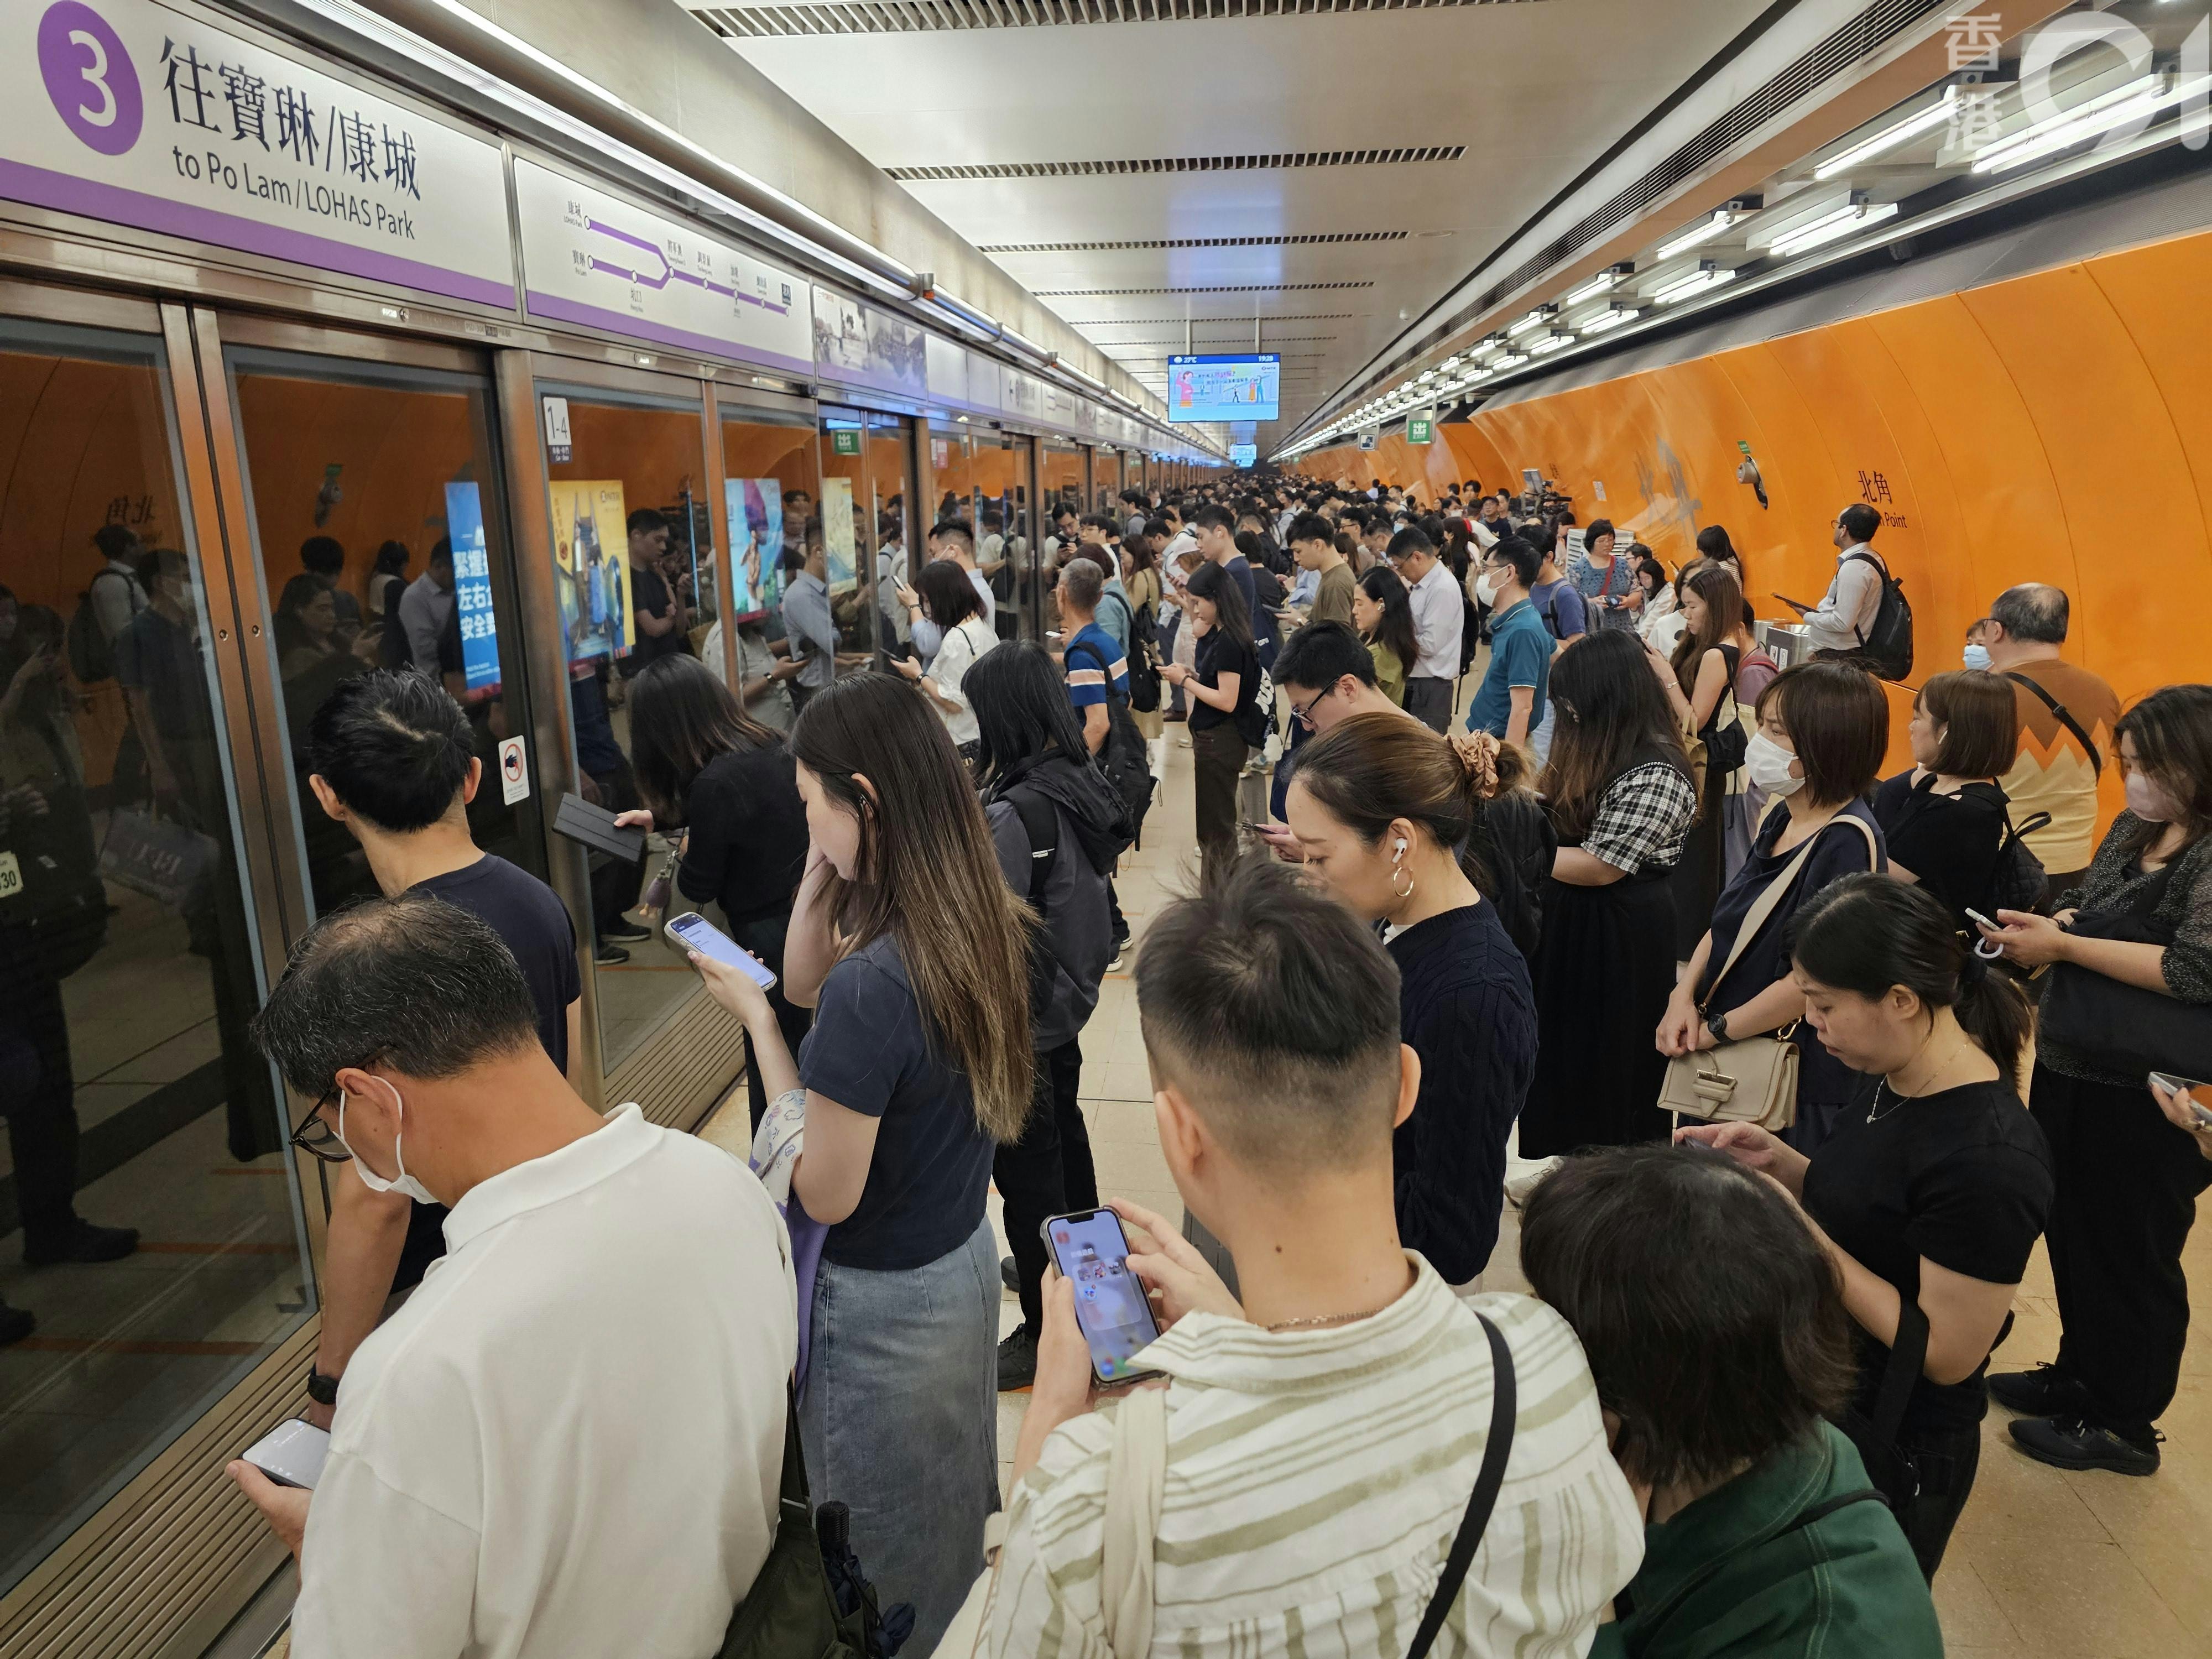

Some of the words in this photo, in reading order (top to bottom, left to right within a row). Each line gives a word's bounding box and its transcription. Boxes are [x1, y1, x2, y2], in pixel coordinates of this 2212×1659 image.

[69, 29, 117, 127] 3
[159, 35, 421, 201] 往寶琳/康城
[173, 145, 200, 179] to
[207, 152, 237, 190] Po
[376, 203, 415, 239] Park
[547, 405, 567, 439] 1-4
[1858, 470, 1893, 505] 北角
[1884, 512, 1908, 529] Point
[0, 870, 17, 891] 30
